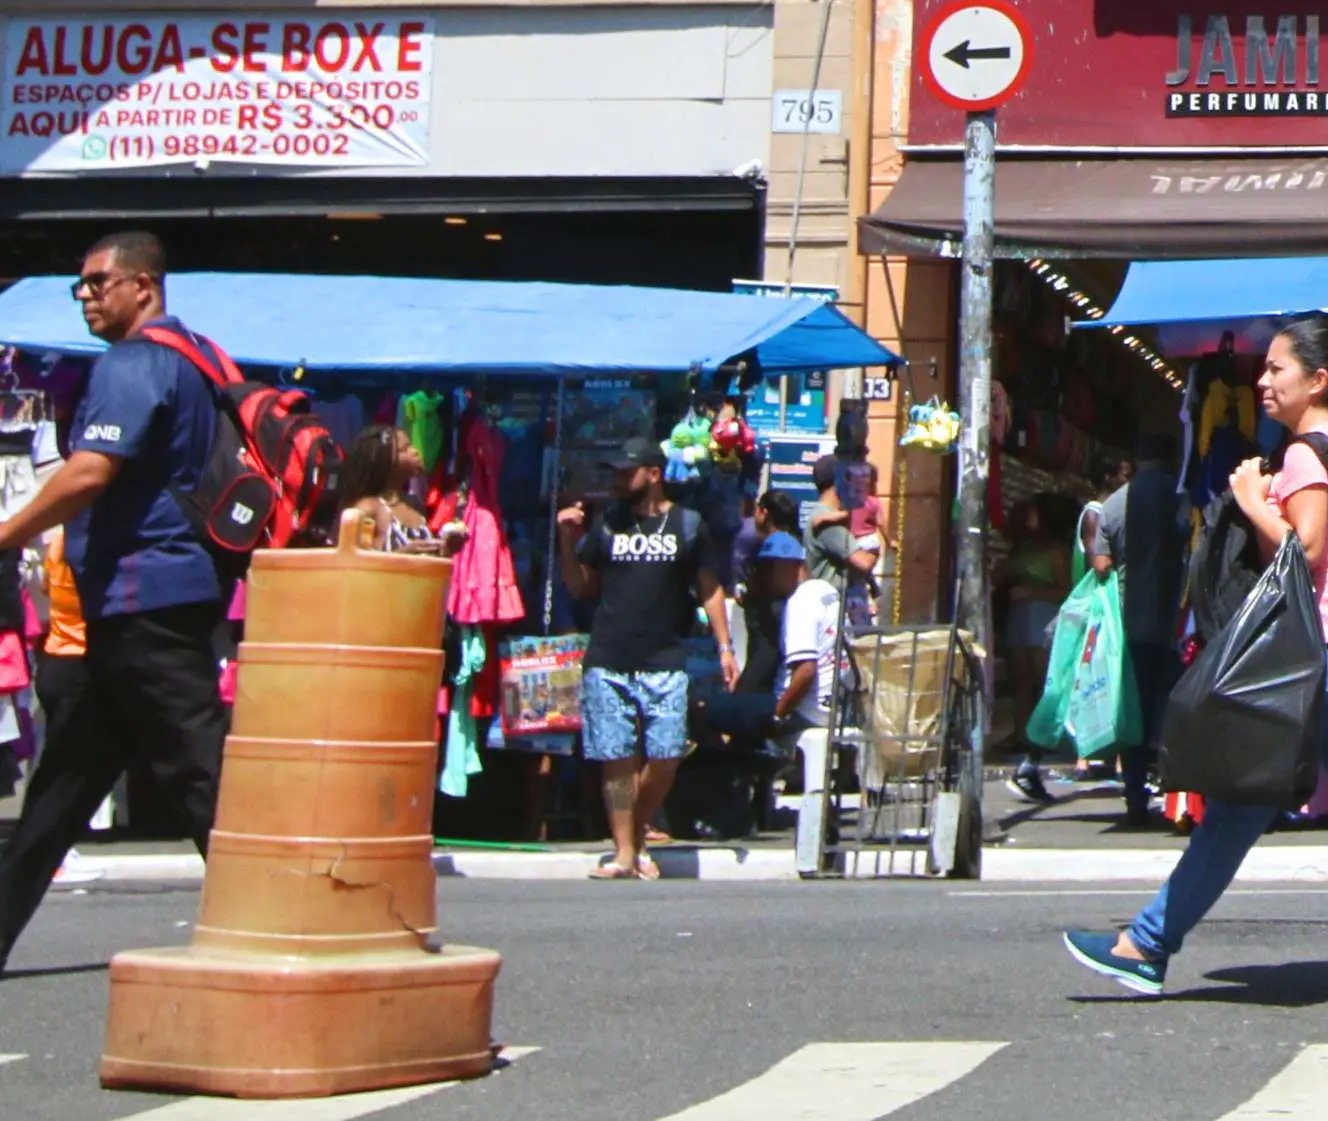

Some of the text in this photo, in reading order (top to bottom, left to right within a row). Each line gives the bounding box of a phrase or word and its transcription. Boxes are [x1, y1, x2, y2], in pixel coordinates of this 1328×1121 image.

[15, 22, 425, 75] ALUGA-SE BOX E
[13, 76, 420, 106] ESPAÇOS P/ LOJAS E DEPÓSITOS
[8, 111, 90, 136] AQUI
[96, 111, 110, 126] A
[117, 109, 197, 126] PARTIR
[202, 109, 232, 125] DE
[237, 101, 283, 132] R$
[782, 99, 833, 124] 795
[108, 134, 350, 160] (11) 98942-0002
[612, 533, 677, 556] BOSS
